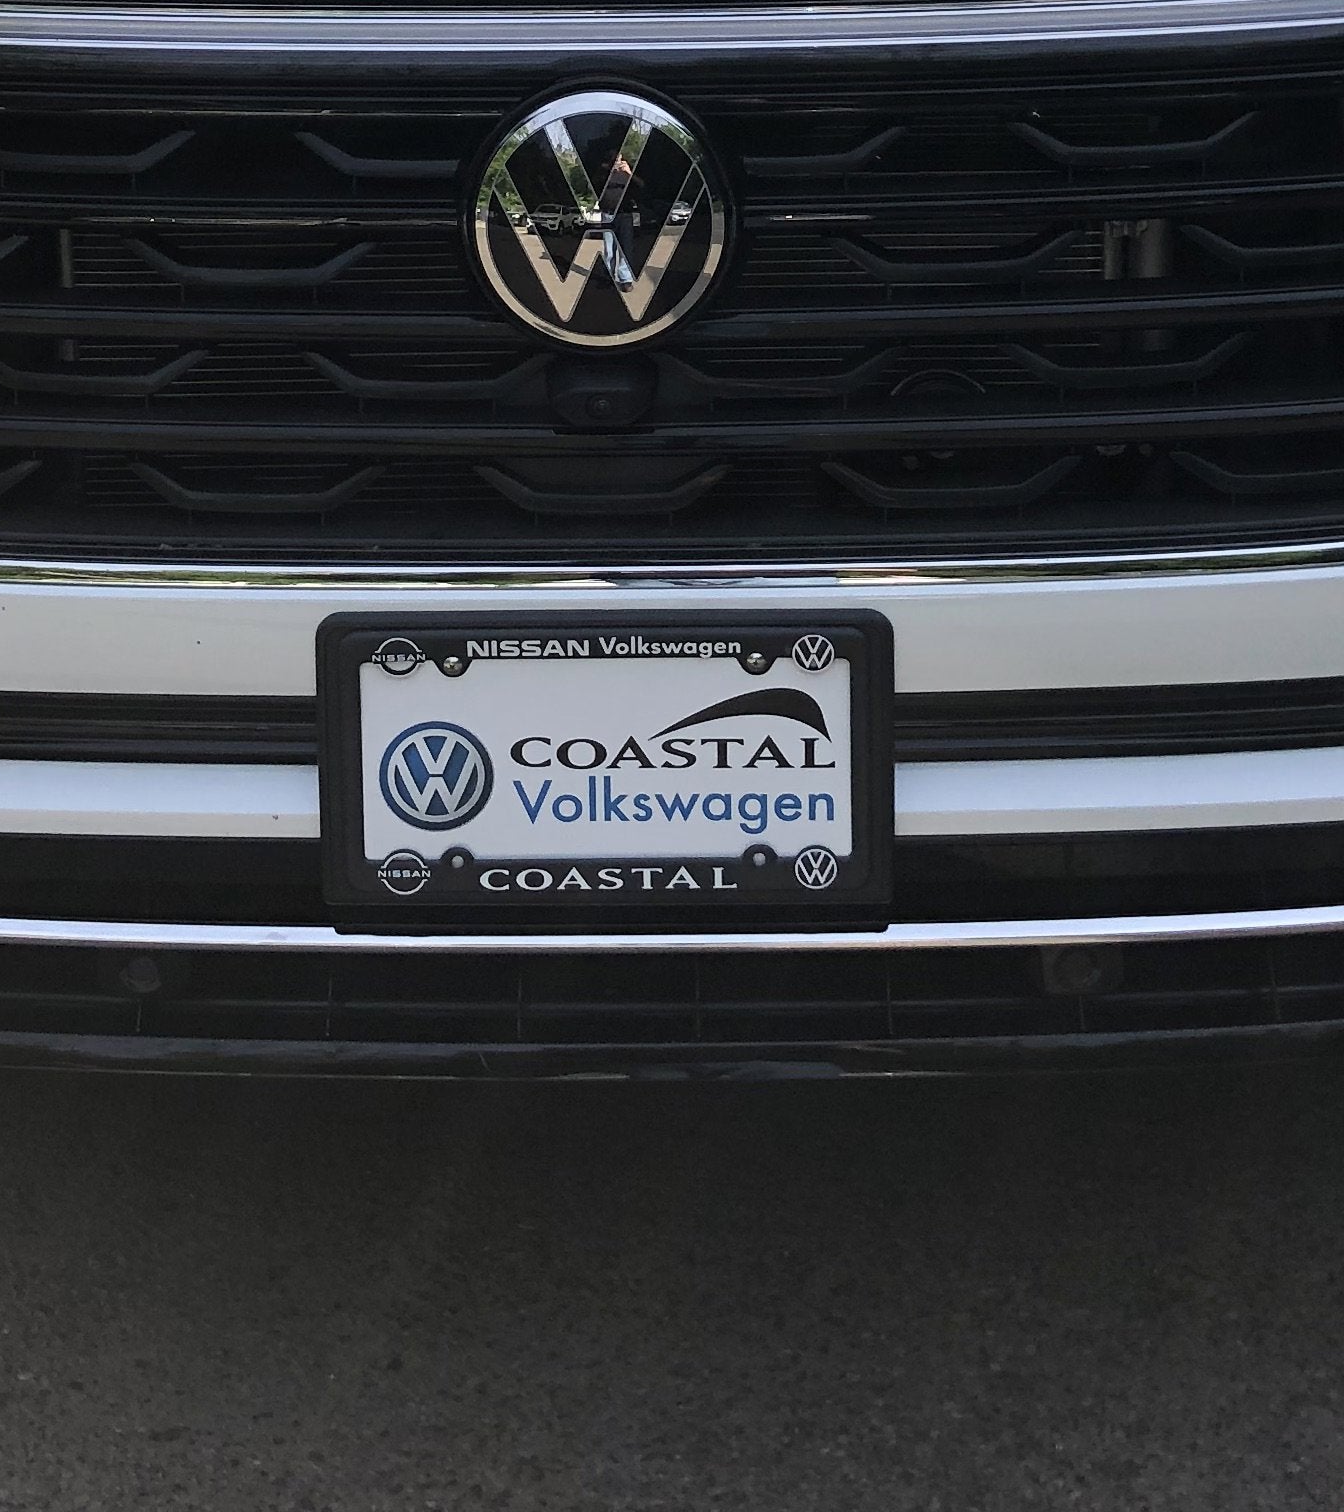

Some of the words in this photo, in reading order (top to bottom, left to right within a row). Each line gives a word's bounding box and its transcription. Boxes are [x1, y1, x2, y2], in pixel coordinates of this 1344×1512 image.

[371, 652, 427, 663] NISSAN
[467, 639, 590, 658] NISSAN
[598, 635, 742, 659] Volkswagen
[509, 734, 836, 770] COASTAL
[513, 775, 835, 835] Volkswagen
[377, 869, 431, 879] NISSAN
[479, 865, 738, 891] COASTAL
